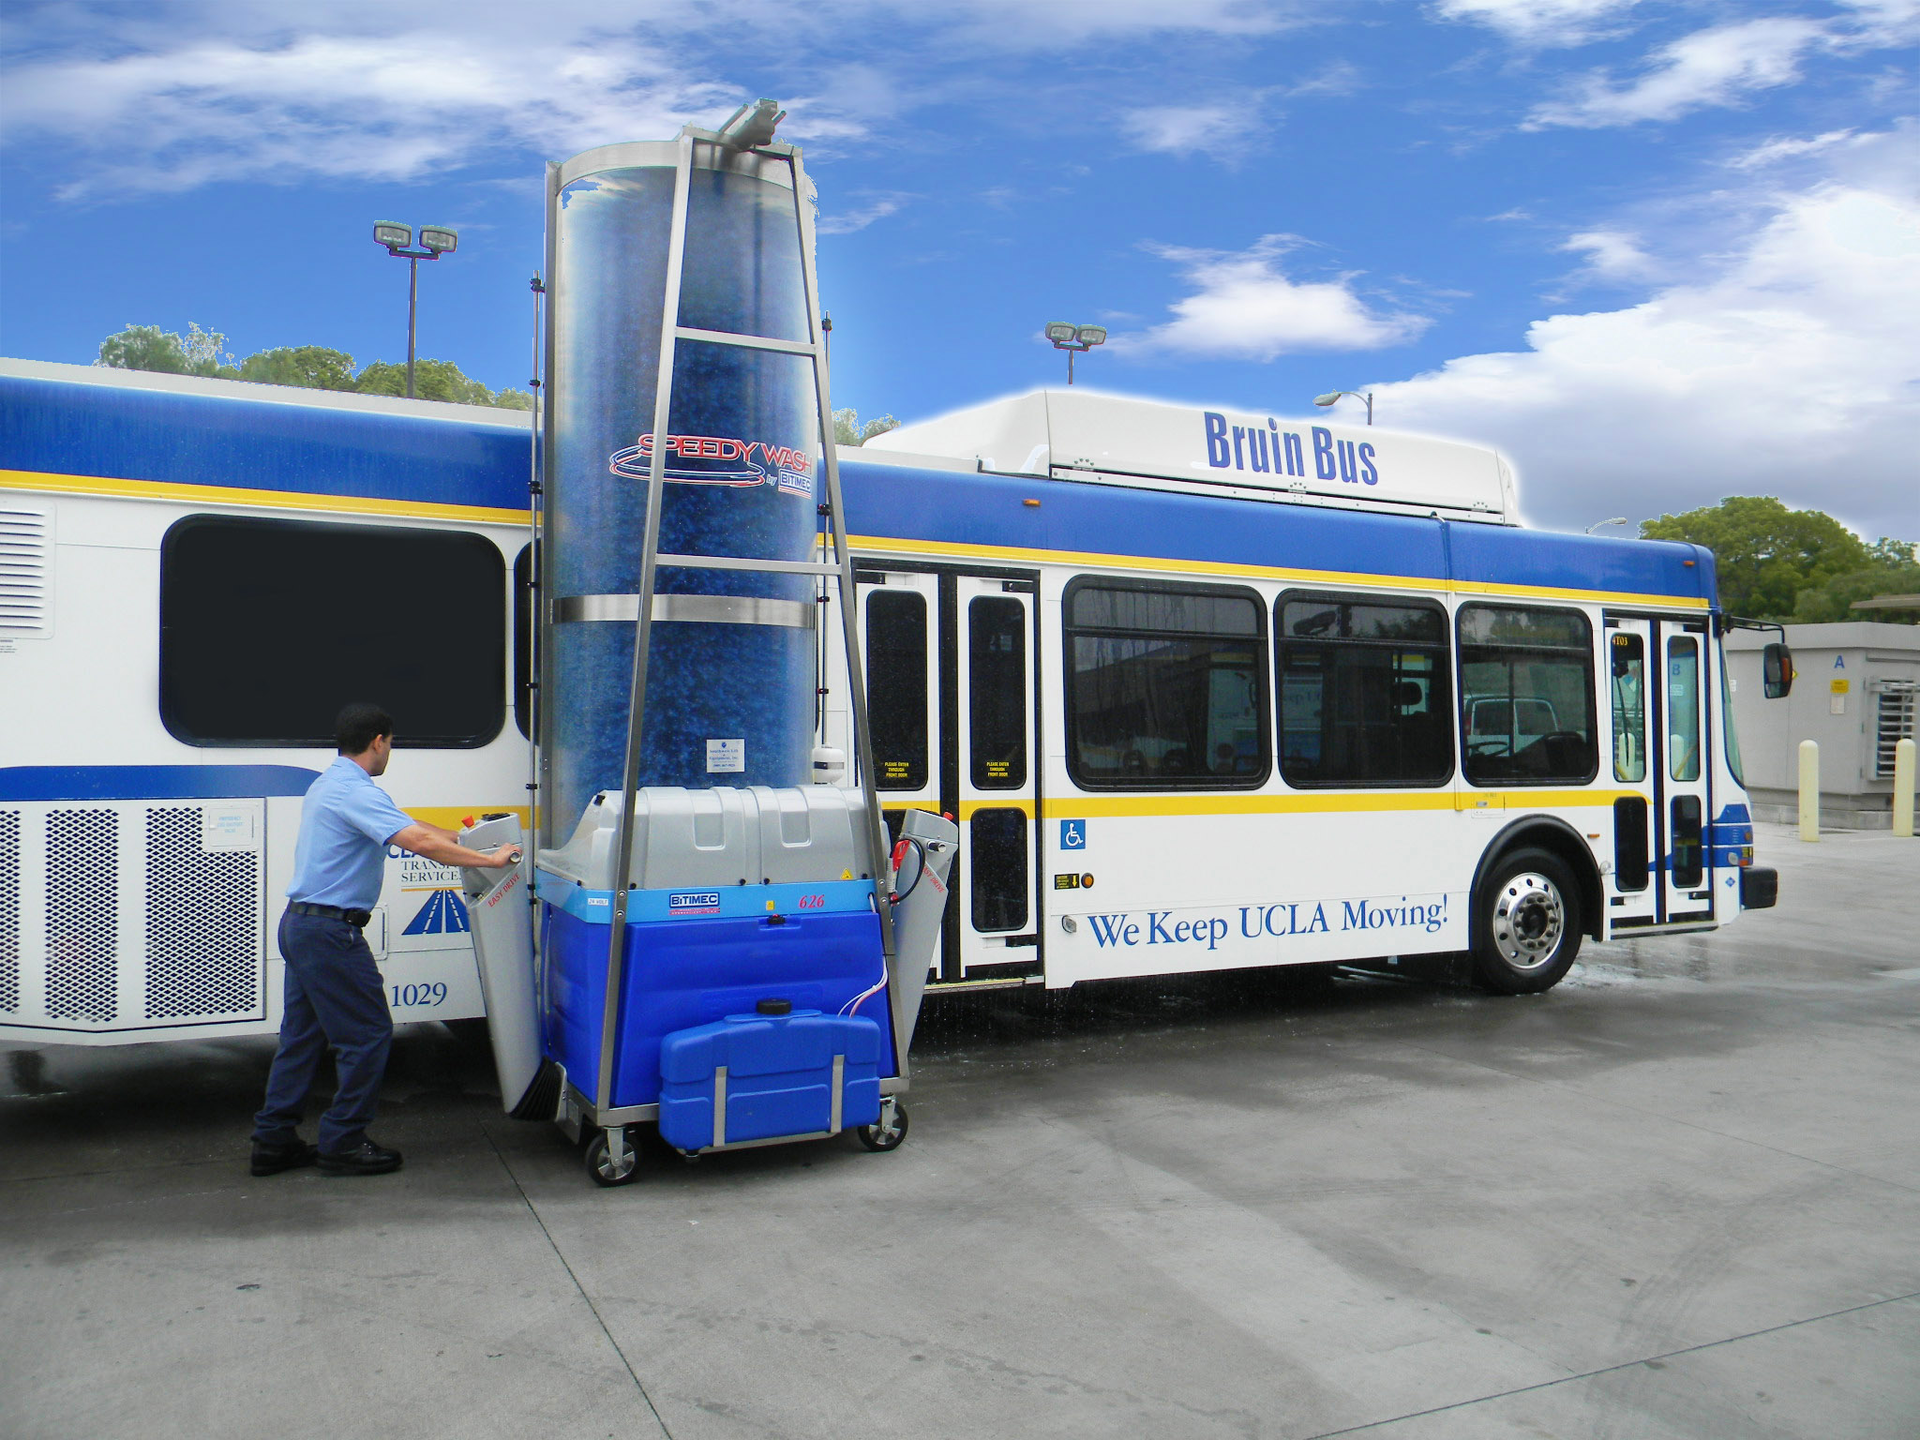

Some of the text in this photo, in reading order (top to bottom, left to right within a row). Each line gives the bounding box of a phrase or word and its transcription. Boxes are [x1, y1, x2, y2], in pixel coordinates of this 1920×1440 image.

[638, 433, 813, 475] SPEEDY WASH
[1204, 411, 1379, 486] Bruin Bus
[766, 473, 778, 487] by
[1834, 654, 1845, 669] A
[401, 870, 463, 883] SERVICE
[930, 877, 946, 893] DRIVE
[487, 872, 521, 908] EASY DRIVE
[799, 894, 825, 909] 626
[1087, 893, 1449, 951] We Keep UCLA Moving!
[391, 982, 448, 1007] 1029
